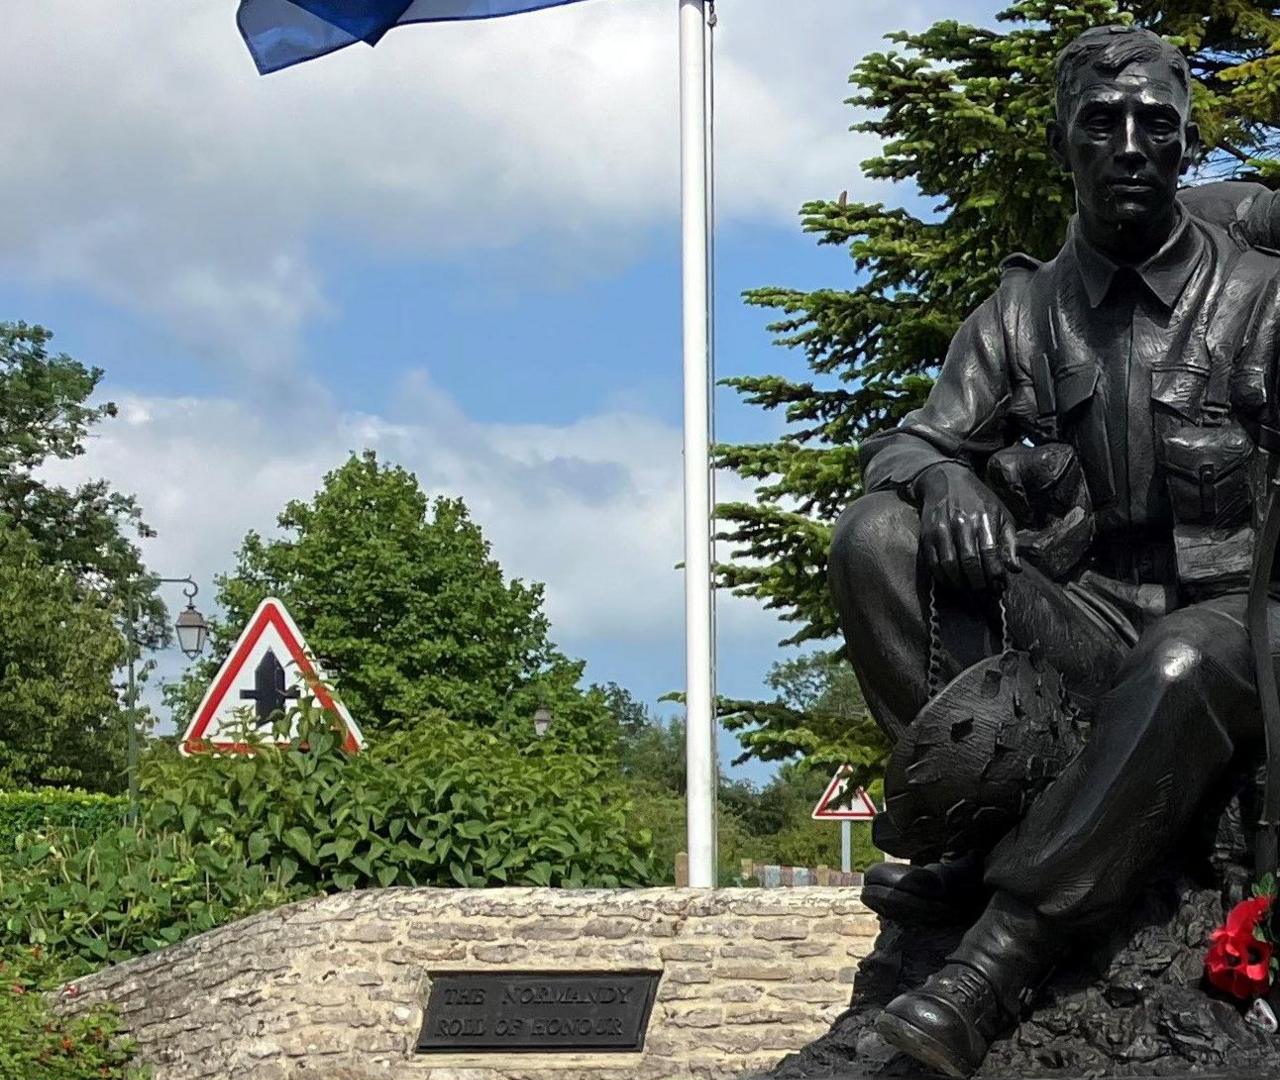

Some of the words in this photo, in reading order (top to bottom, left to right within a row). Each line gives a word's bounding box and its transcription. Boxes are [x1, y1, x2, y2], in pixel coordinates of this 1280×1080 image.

[444, 987, 487, 1006] THE
[502, 986, 634, 1006] NORMANDY
[434, 1018, 487, 1037] ROLL
[494, 1018, 525, 1037] OF
[530, 1017, 624, 1037] HONOUR
